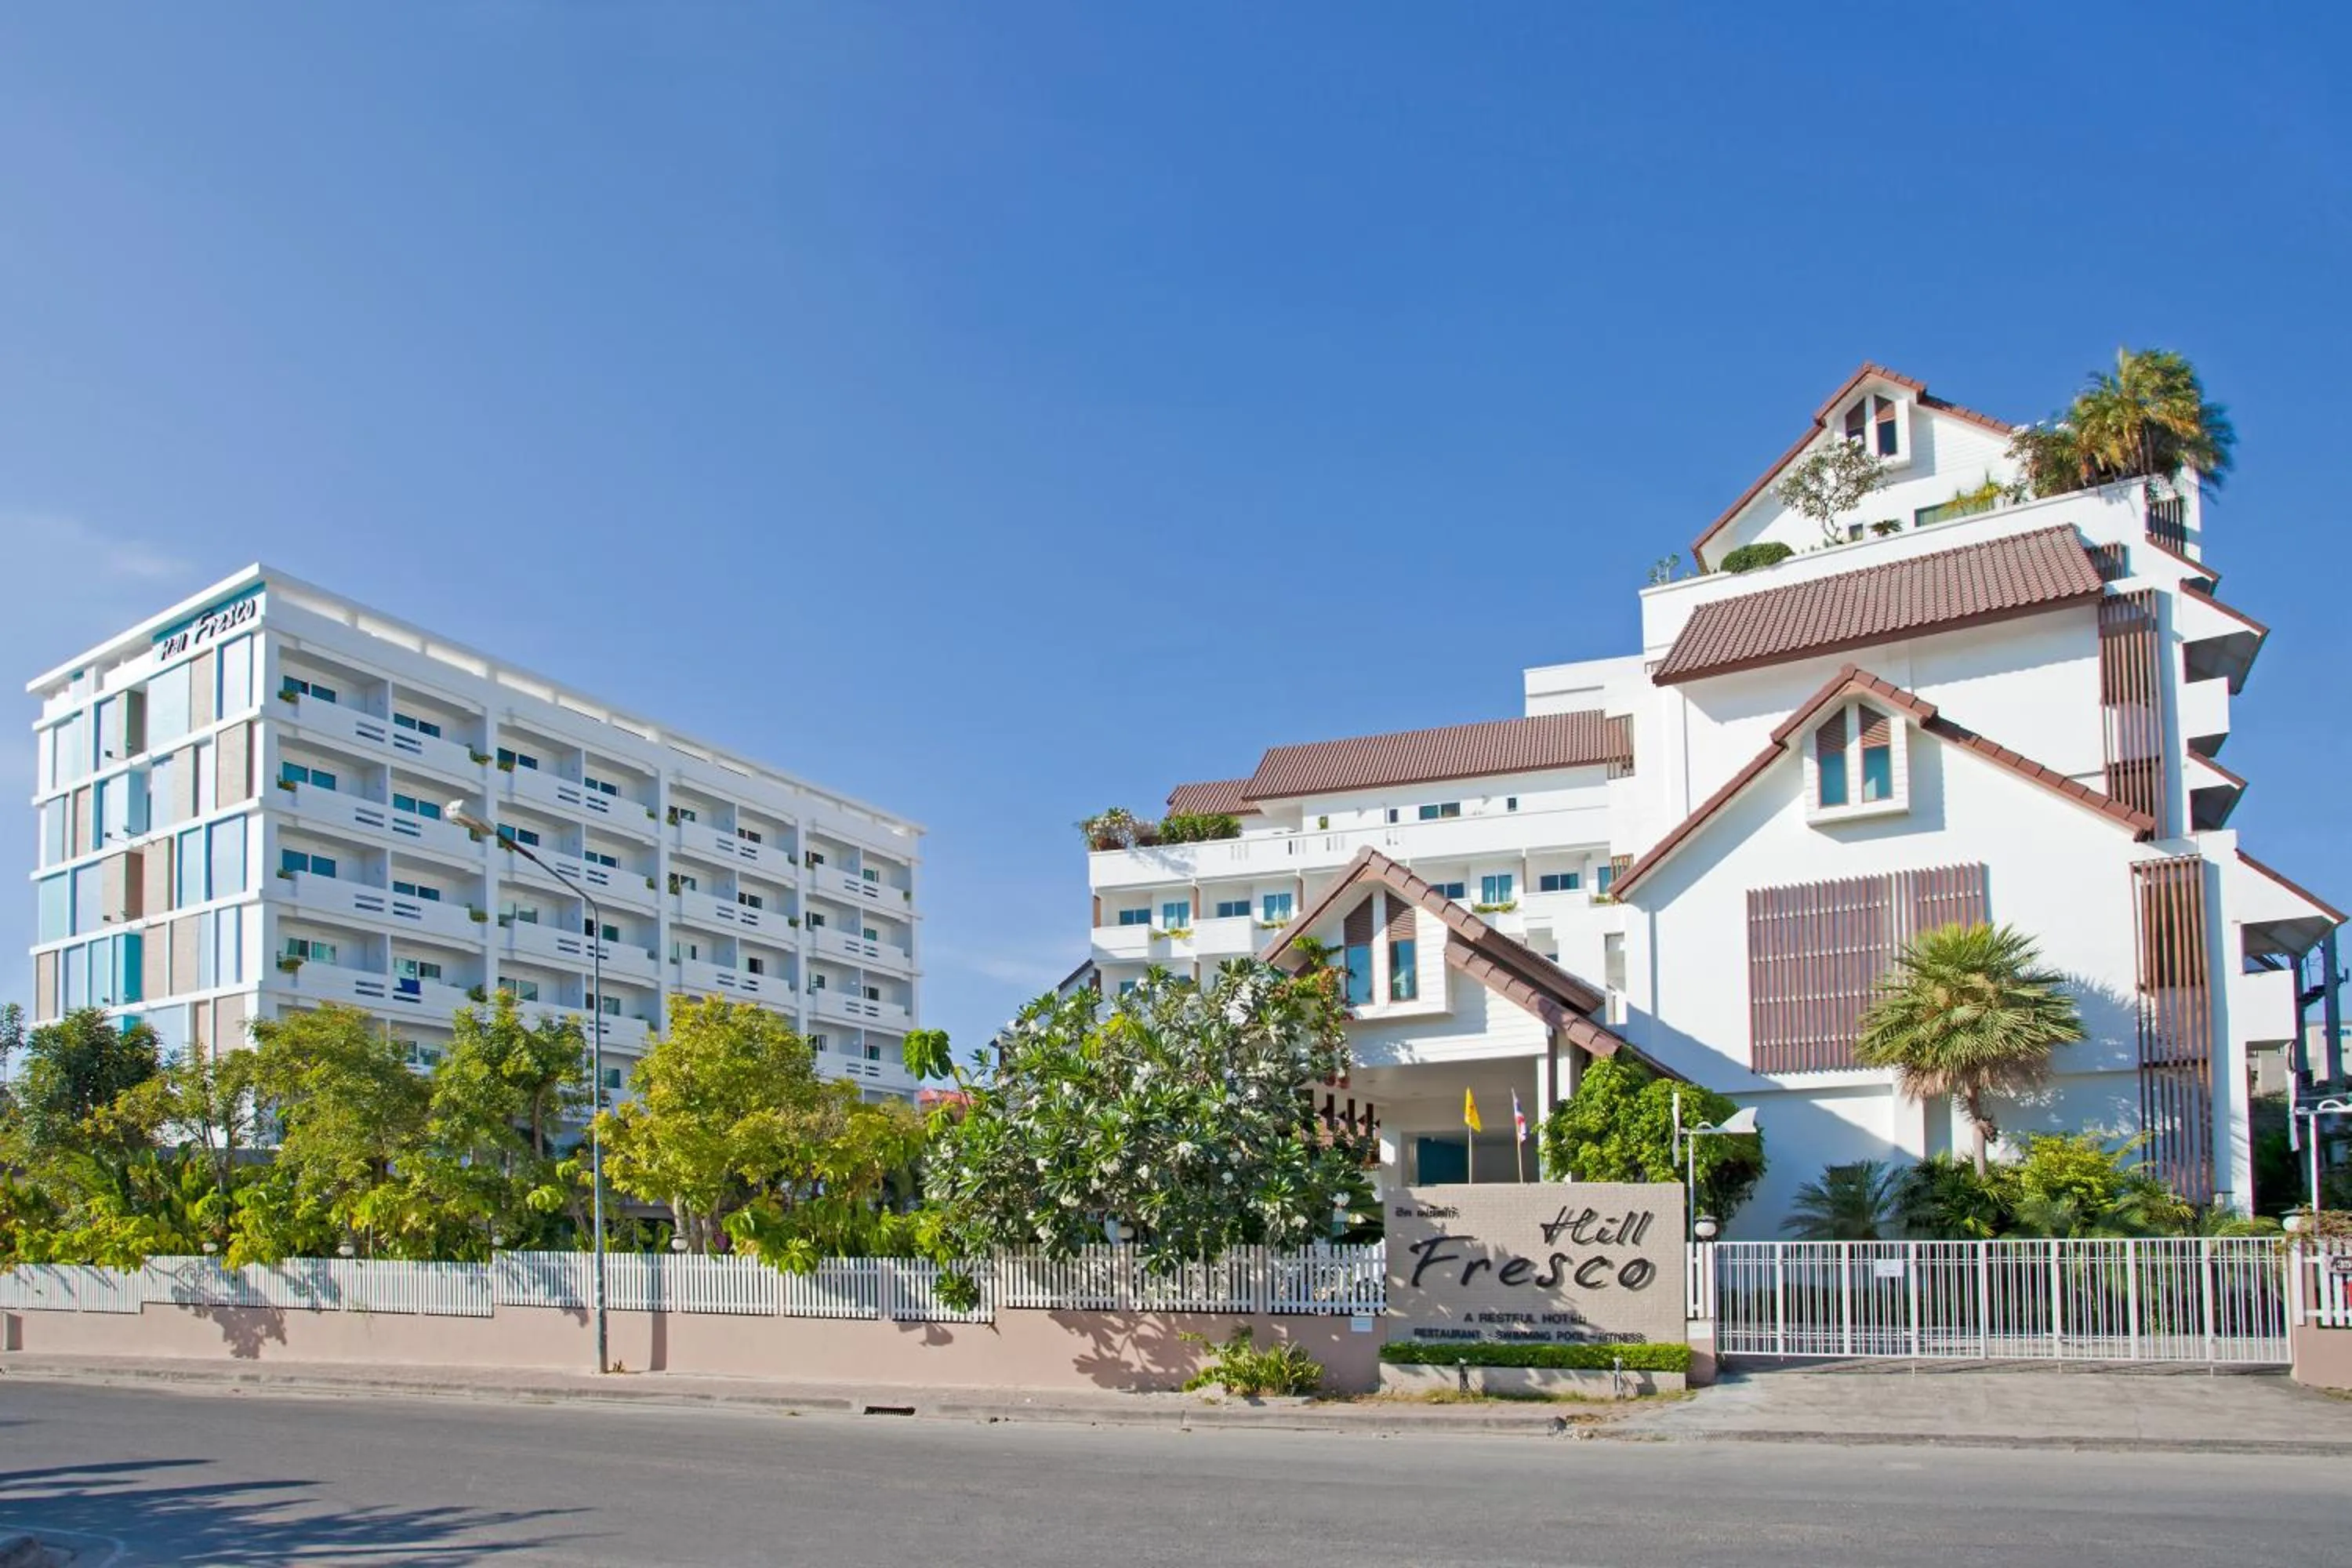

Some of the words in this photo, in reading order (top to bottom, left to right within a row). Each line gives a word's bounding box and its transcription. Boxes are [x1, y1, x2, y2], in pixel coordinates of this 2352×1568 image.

[194, 598, 256, 644] Fresco
[1541, 1205, 1653, 1246] Hill
[1410, 1235, 1655, 1290] Fresco
[1414, 1327, 1480, 1339] RESTAURANT
[1494, 1330, 1551, 1341] SWIMMING
[1557, 1330, 1585, 1341] POOL
[1464, 1312, 1473, 1323] A
[1479, 1313, 1535, 1323] RESTFUL
[1542, 1313, 1587, 1324] HOTEL
